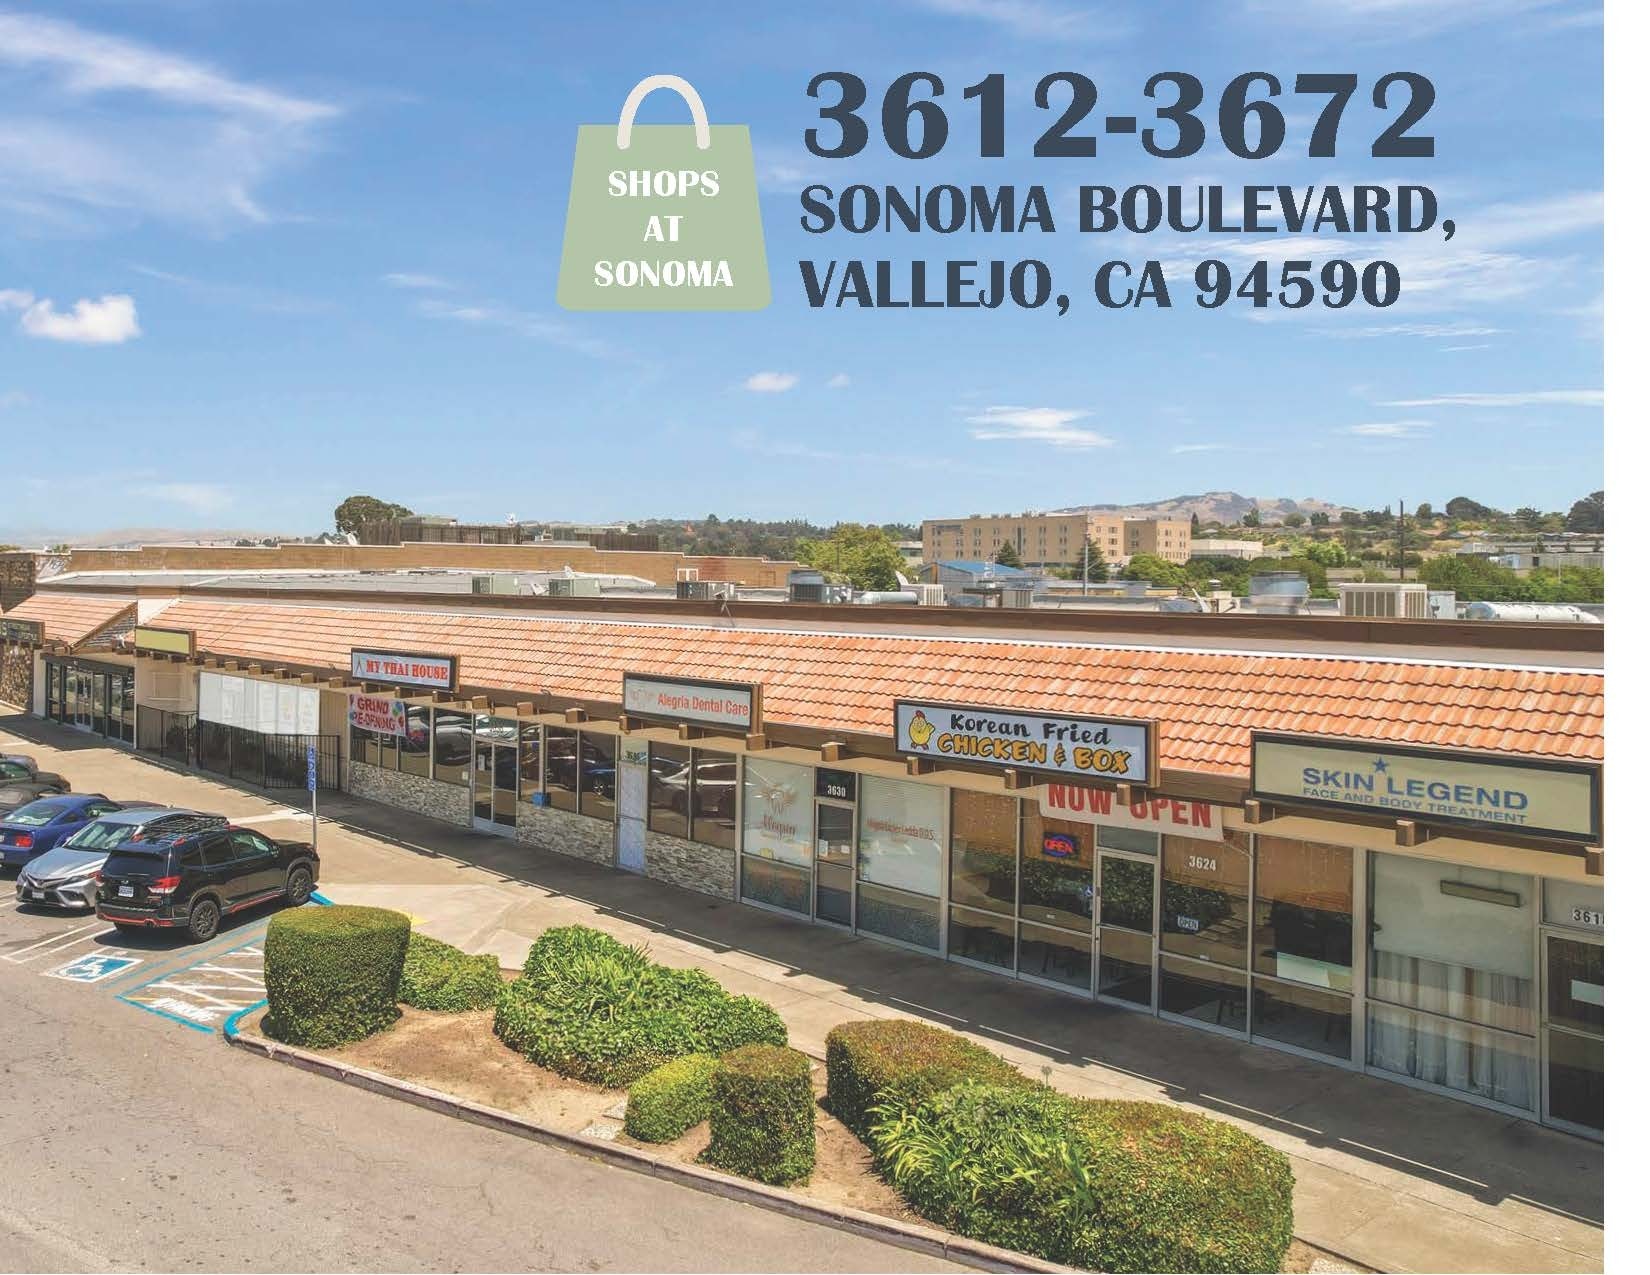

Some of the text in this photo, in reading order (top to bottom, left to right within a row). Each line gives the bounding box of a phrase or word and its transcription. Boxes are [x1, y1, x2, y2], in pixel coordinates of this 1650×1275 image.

[366, 660, 448, 680] MY THAI HOUSE
[657, 693, 749, 716] Alegria Dental Care
[950, 713, 1112, 746] Korean Fried
[936, 732, 1132, 775] CHICKEN & BOX
[827, 784, 847, 798] 3630
[1302, 767, 1529, 811] SKIN LEGEND
[1048, 784, 1213, 829] NOW OPEN
[1303, 787, 1529, 825] FACE AND BODY TREATMENT
[1188, 854, 1217, 872] 3624
[1572, 908, 1604, 926] 361
